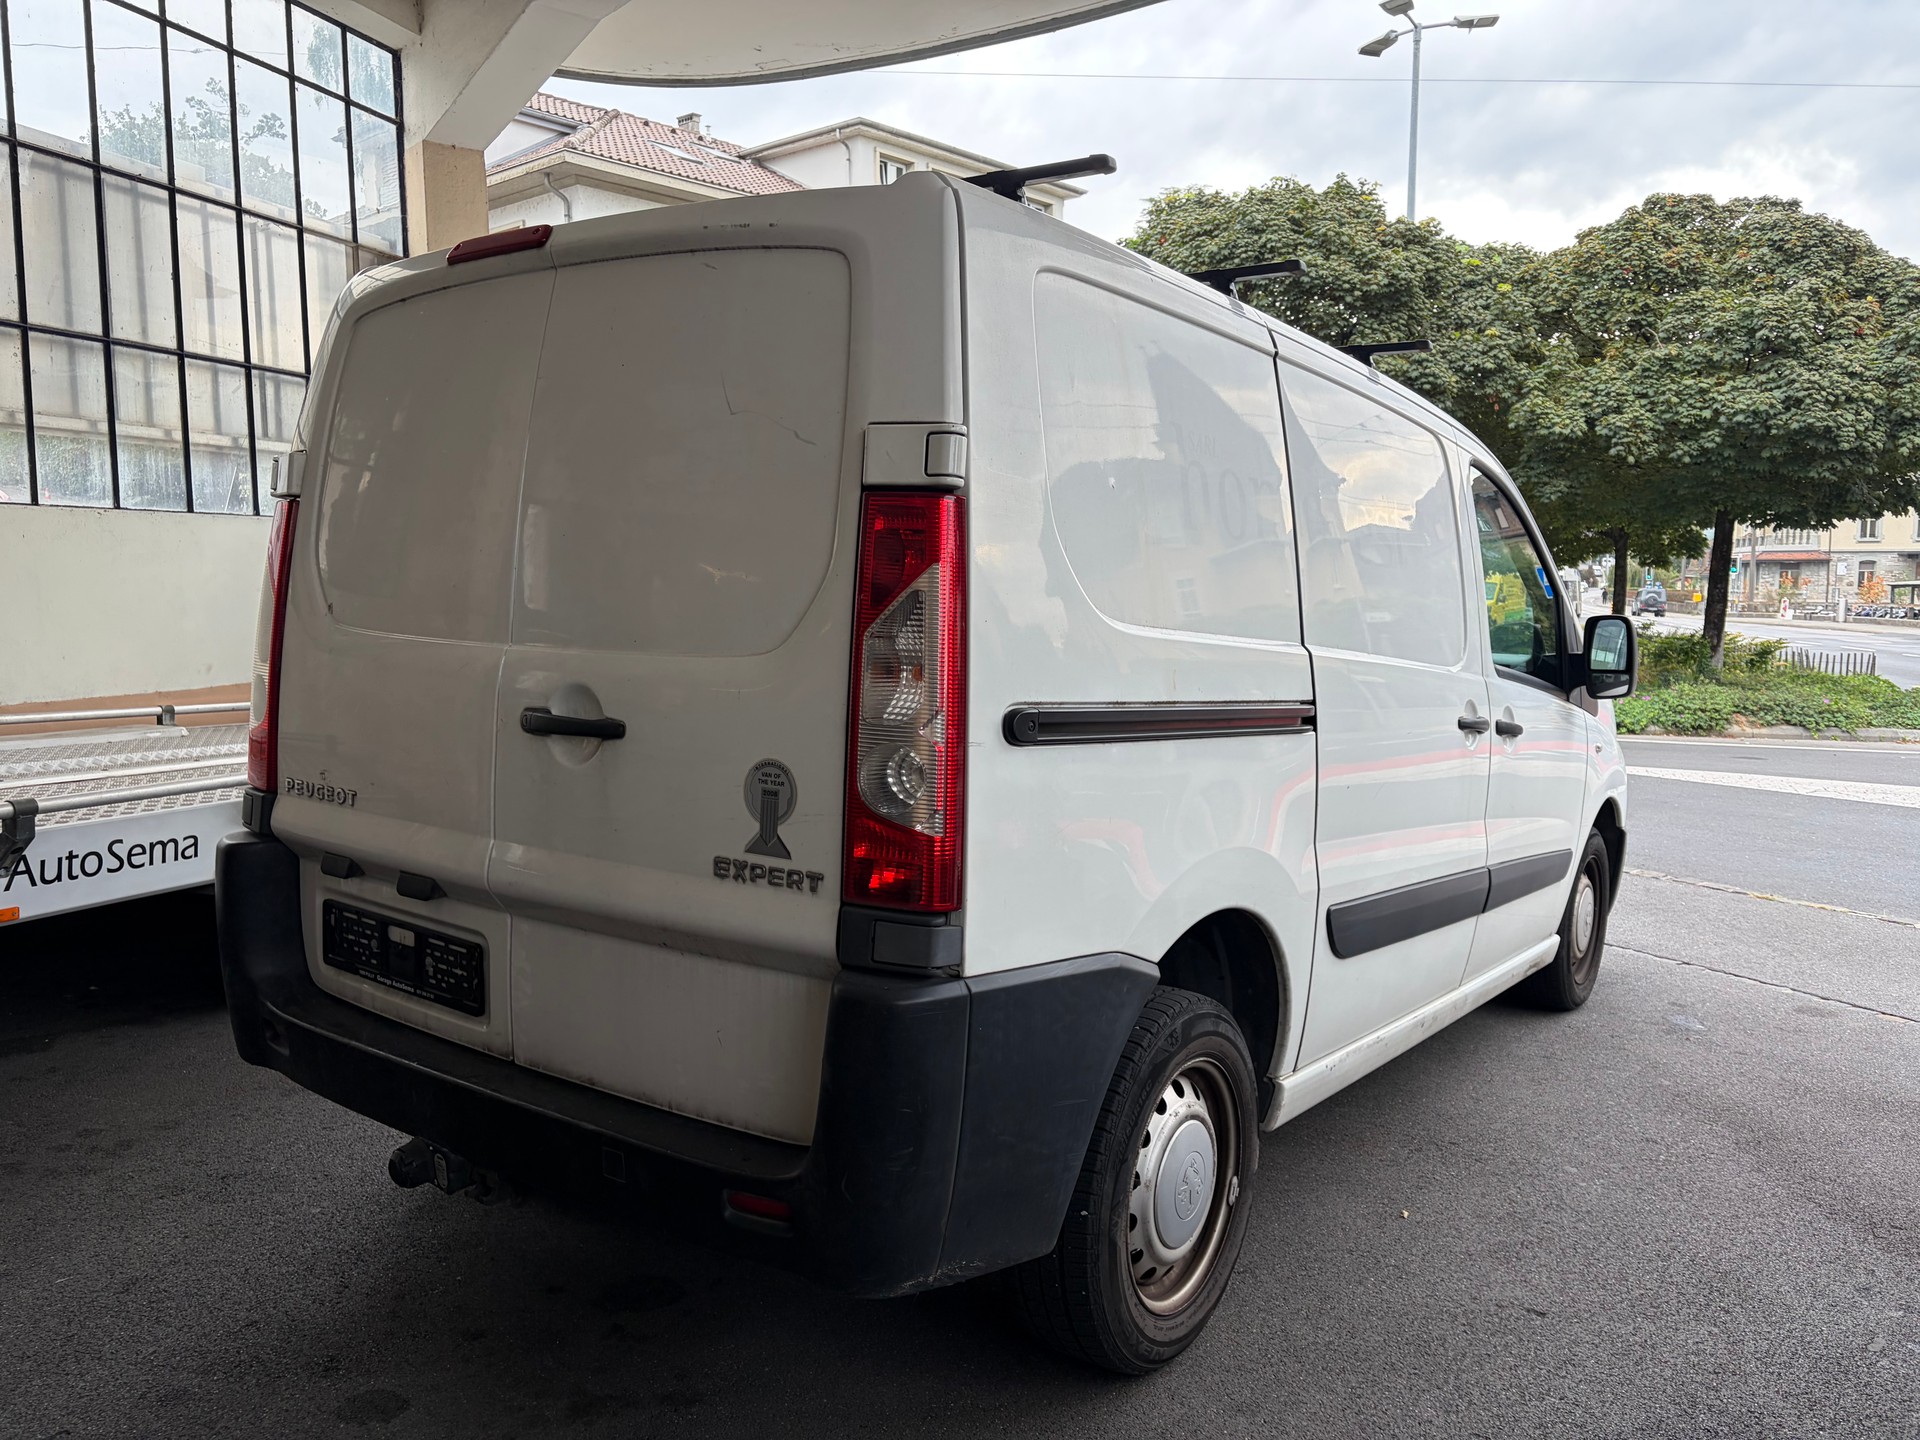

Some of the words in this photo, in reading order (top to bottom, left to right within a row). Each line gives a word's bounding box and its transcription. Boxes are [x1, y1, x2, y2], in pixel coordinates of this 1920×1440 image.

[754, 761, 790, 776] INTERNATIONAL
[285, 776, 357, 807] PEUGEOT
[3, 834, 199, 892] AutoSema
[713, 856, 824, 893] EXPERT
